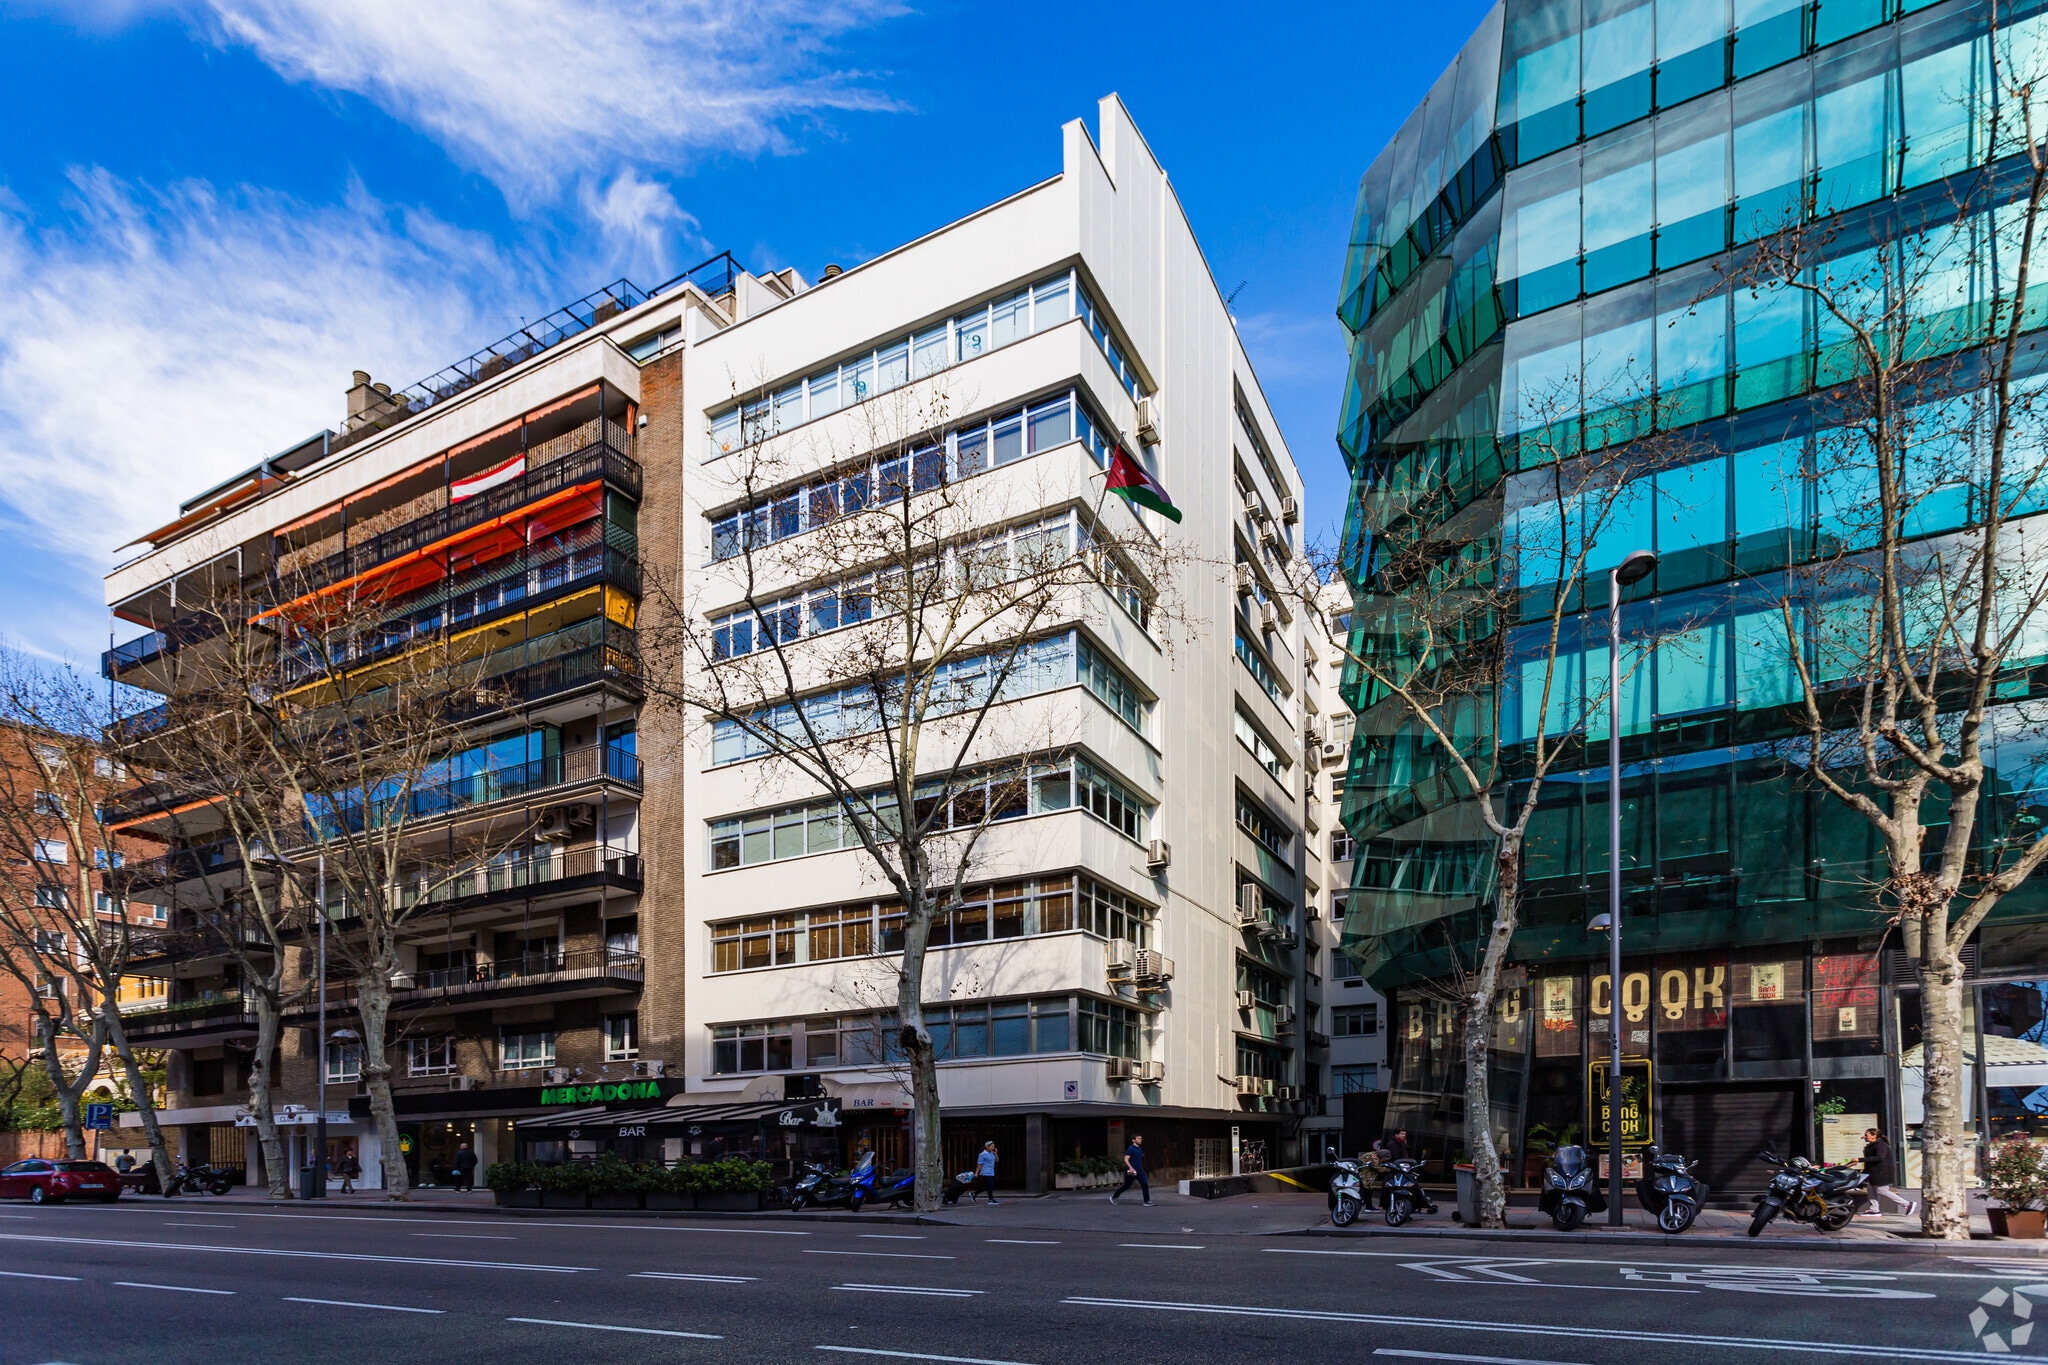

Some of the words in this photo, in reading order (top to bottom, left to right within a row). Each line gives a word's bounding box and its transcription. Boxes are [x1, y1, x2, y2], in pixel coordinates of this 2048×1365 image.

[1408, 988, 1521, 1040] BAG
[1590, 966, 1726, 1022] COOK
[541, 1081, 662, 1105] MERCADONA
[853, 1099, 874, 1107] BAR
[92, 1105, 107, 1121] P
[778, 1110, 804, 1126] Bar
[1601, 1104, 1639, 1120] BNG
[618, 1126, 646, 1137] BAR
[1602, 1120, 1639, 1135] COK
